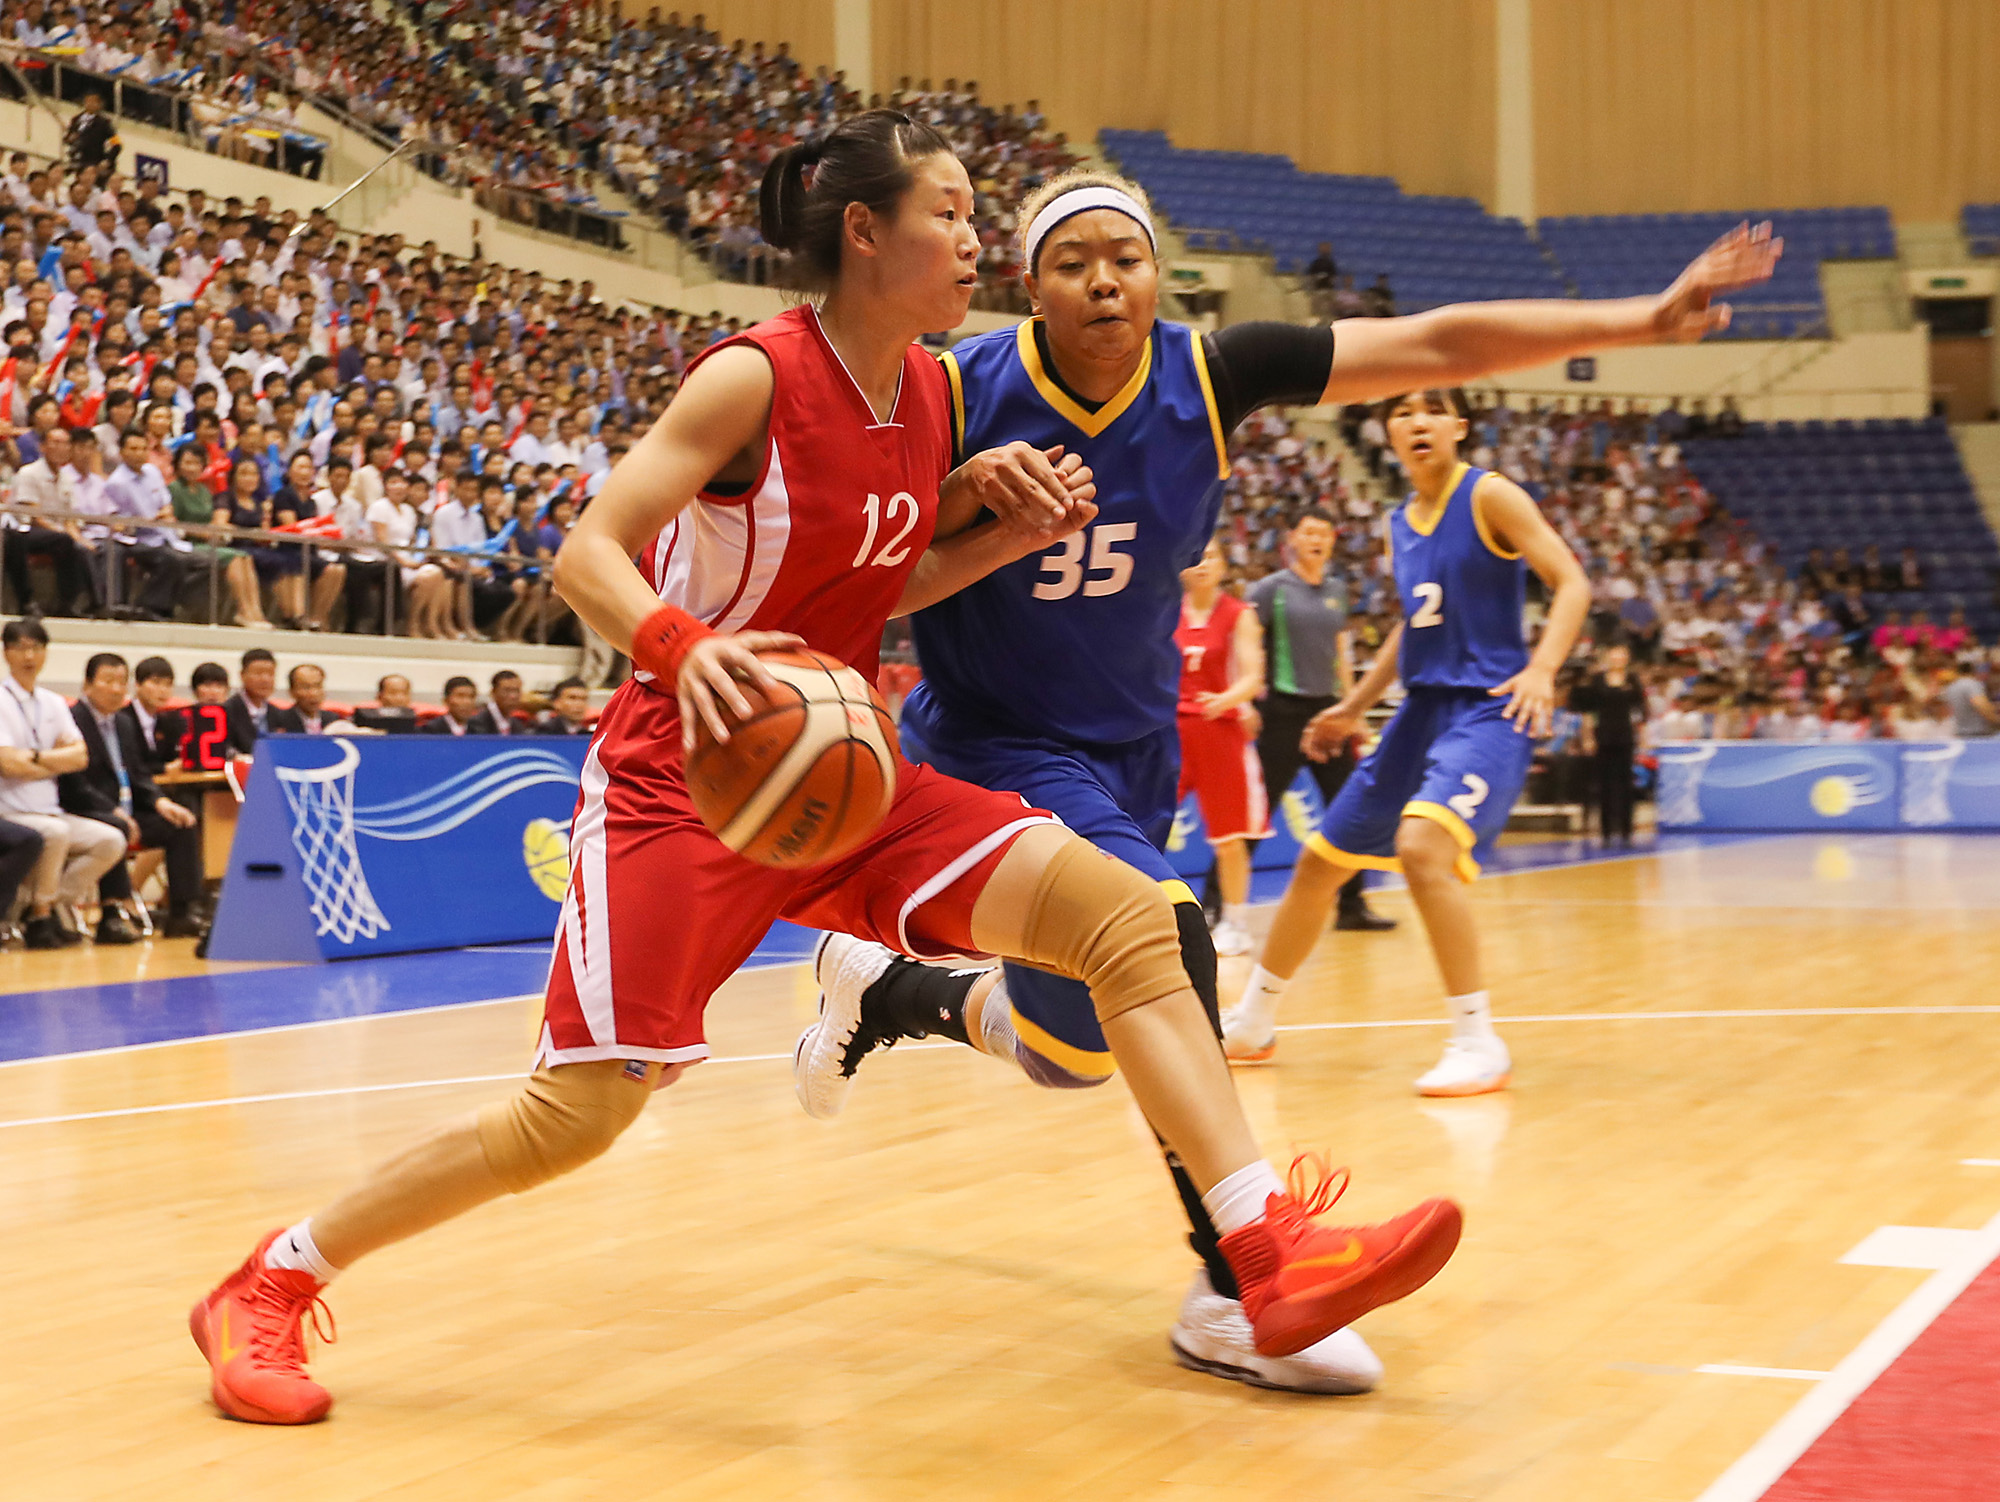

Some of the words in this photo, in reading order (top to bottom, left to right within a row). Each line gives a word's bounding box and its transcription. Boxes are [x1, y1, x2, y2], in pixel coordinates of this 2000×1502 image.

[852, 491, 919, 568] 12
[1031, 521, 1138, 601] 35
[1410, 582, 1444, 628] 2
[1182, 646, 1206, 671] 7
[1448, 774, 1490, 819] 2
